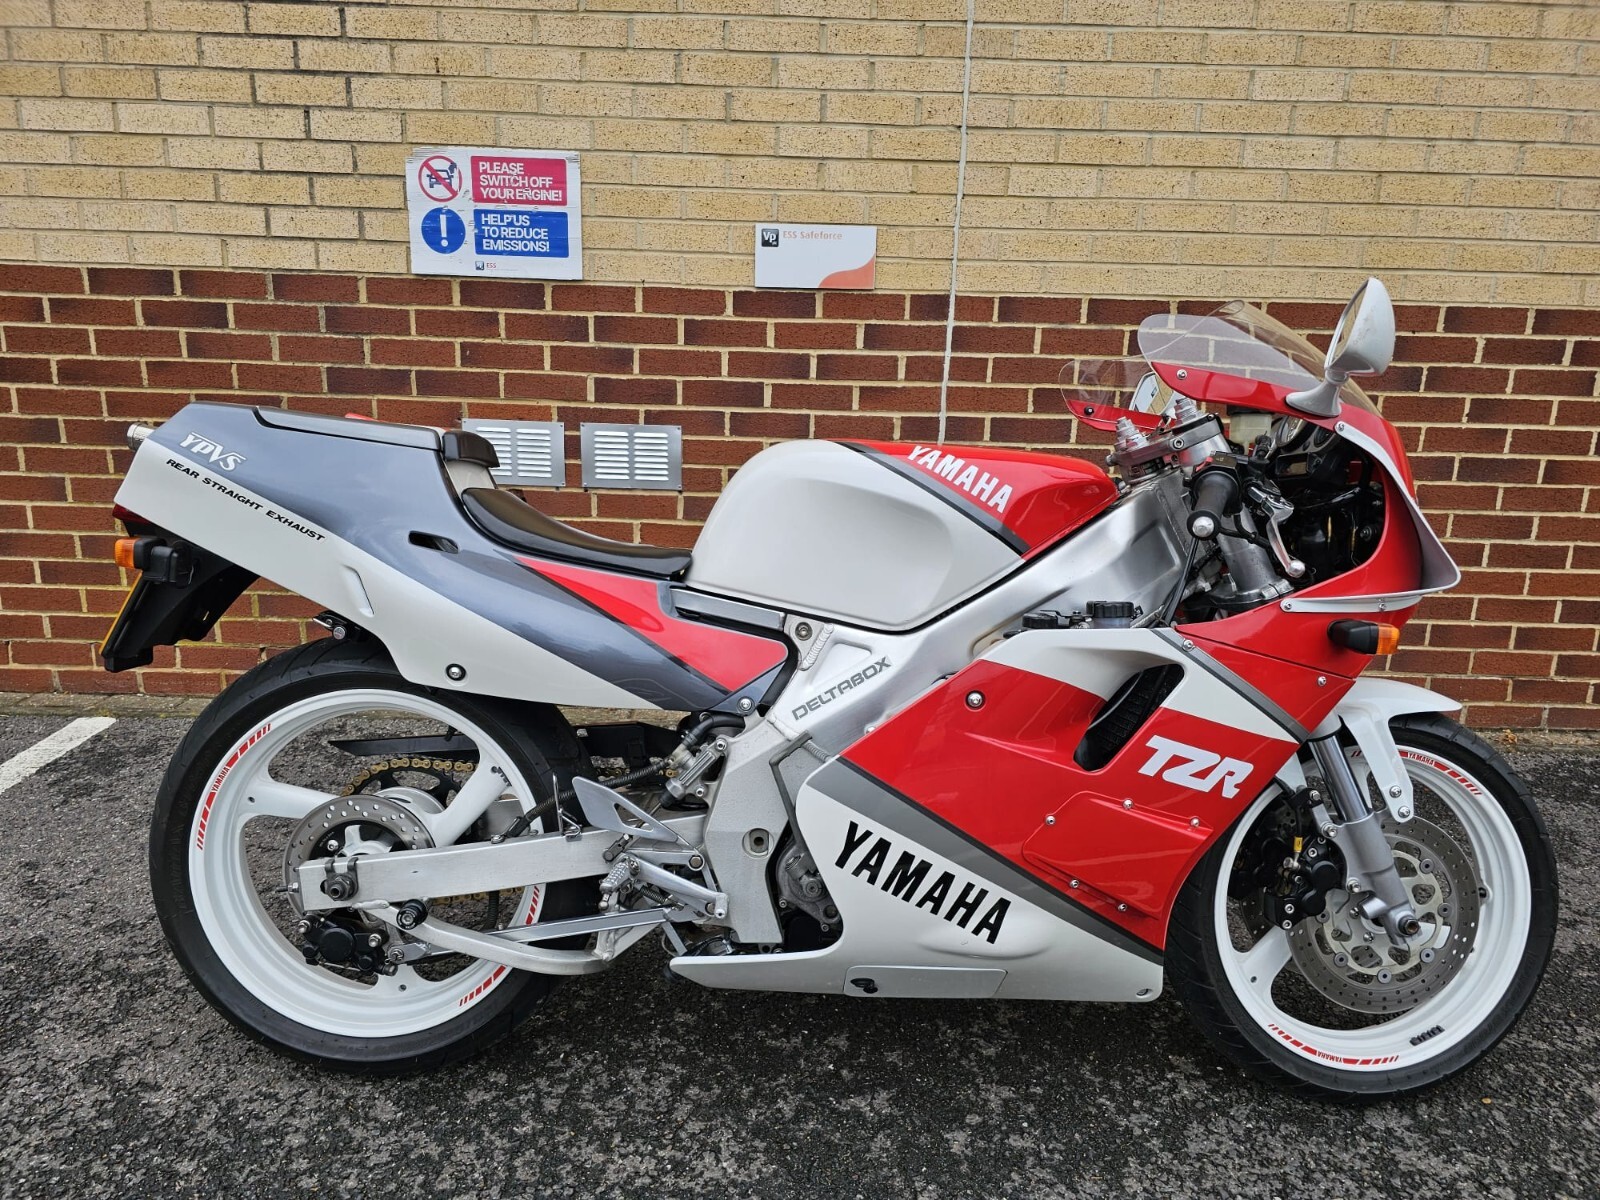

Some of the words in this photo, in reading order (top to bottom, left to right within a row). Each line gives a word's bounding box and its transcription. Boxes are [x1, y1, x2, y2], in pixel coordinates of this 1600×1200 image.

[479, 161, 524, 175] PLEASE
[479, 174, 528, 188] SWITCH
[529, 176, 553, 189] OFF
[480, 187, 514, 200] YOUR
[515, 188, 563, 202] ENGINE!
[481, 213, 512, 225] HELP
[513, 214, 530, 226] US
[483, 226, 500, 238] TO
[501, 227, 548, 240] REDUCE
[763, 231, 777, 243] Vp
[783, 230, 798, 239] ESS
[800, 230, 843, 240] Safeforce
[483, 239, 550, 252] EMISSIONS!
[180, 432, 246, 471] YPVS
[907, 445, 1013, 514] YAMAHA
[166, 458, 200, 479] REAR
[202, 477, 264, 511] STRAIGHT
[266, 509, 326, 542] EXHAUST
[791, 656, 892, 721] DELTABOX
[1137, 734, 1254, 799] TZR
[1409, 752, 1435, 766] YAMAHA
[211, 766, 230, 792] YAMAHA
[834, 820, 1012, 945] YAMAHA
[1317, 1050, 1343, 1063] YAMAHA
